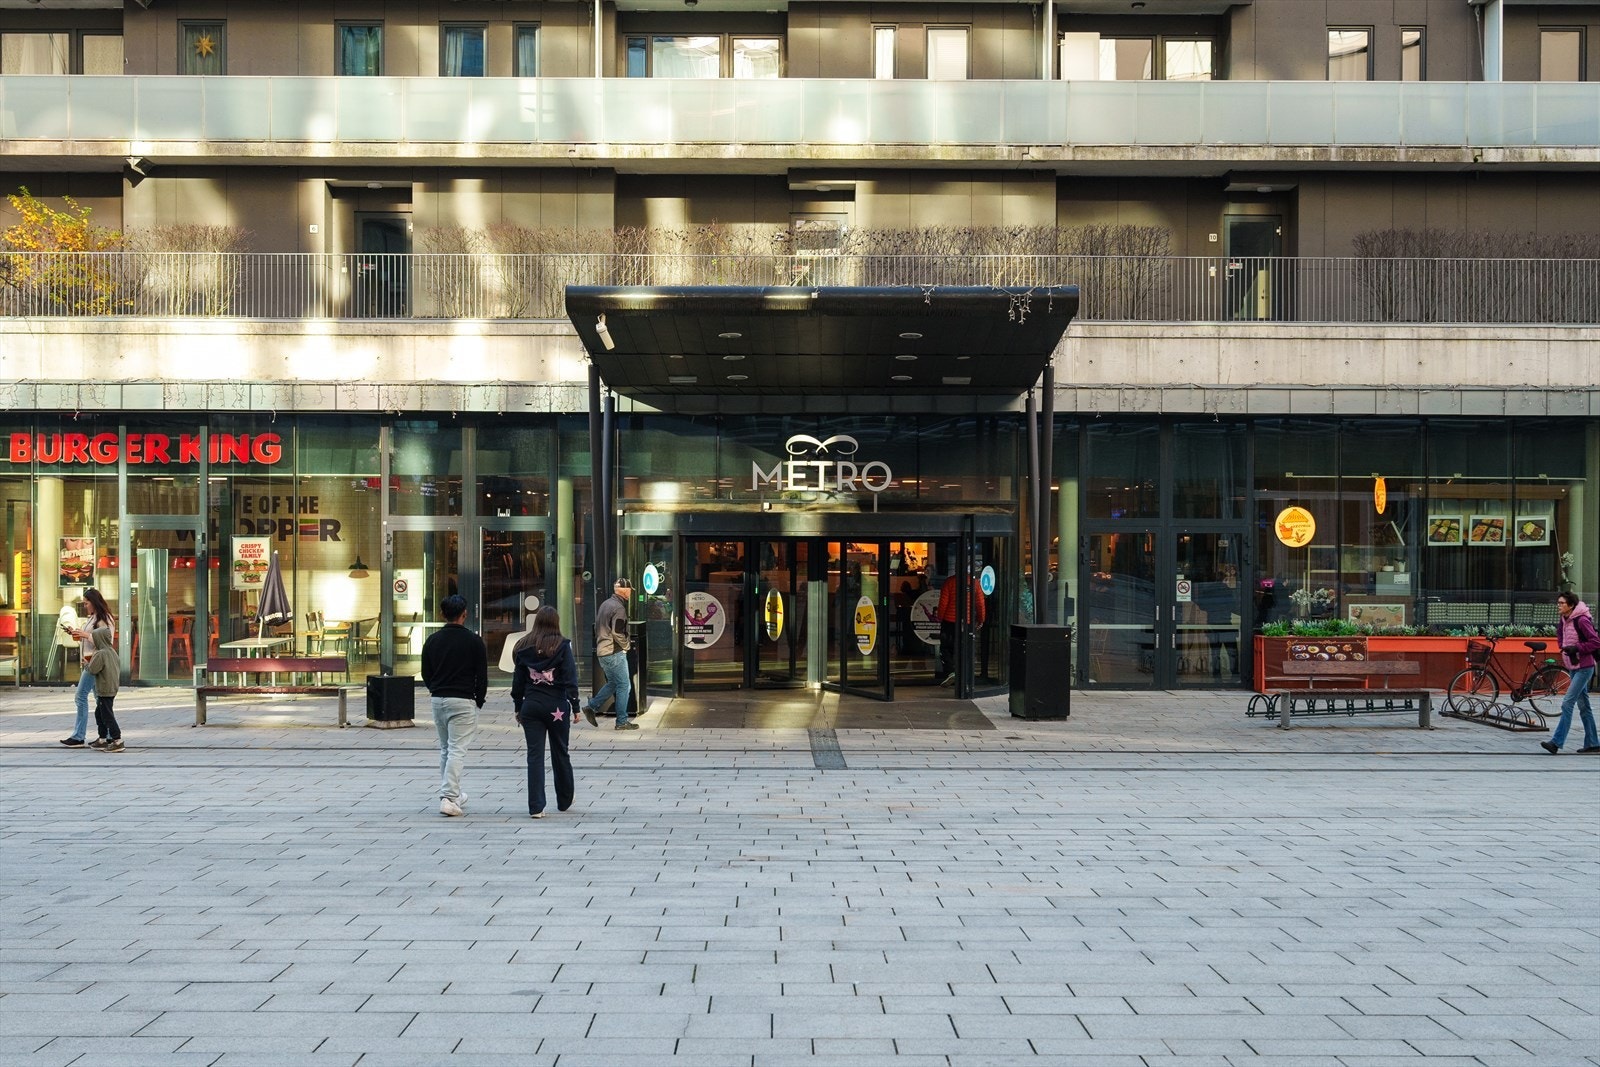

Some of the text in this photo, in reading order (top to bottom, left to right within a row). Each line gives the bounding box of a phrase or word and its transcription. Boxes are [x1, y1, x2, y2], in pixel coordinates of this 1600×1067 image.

[9, 433, 282, 464] BURGER KING
[752, 460, 893, 492] METRO
[258, 495, 281, 514] OF
[286, 495, 319, 514] THE
